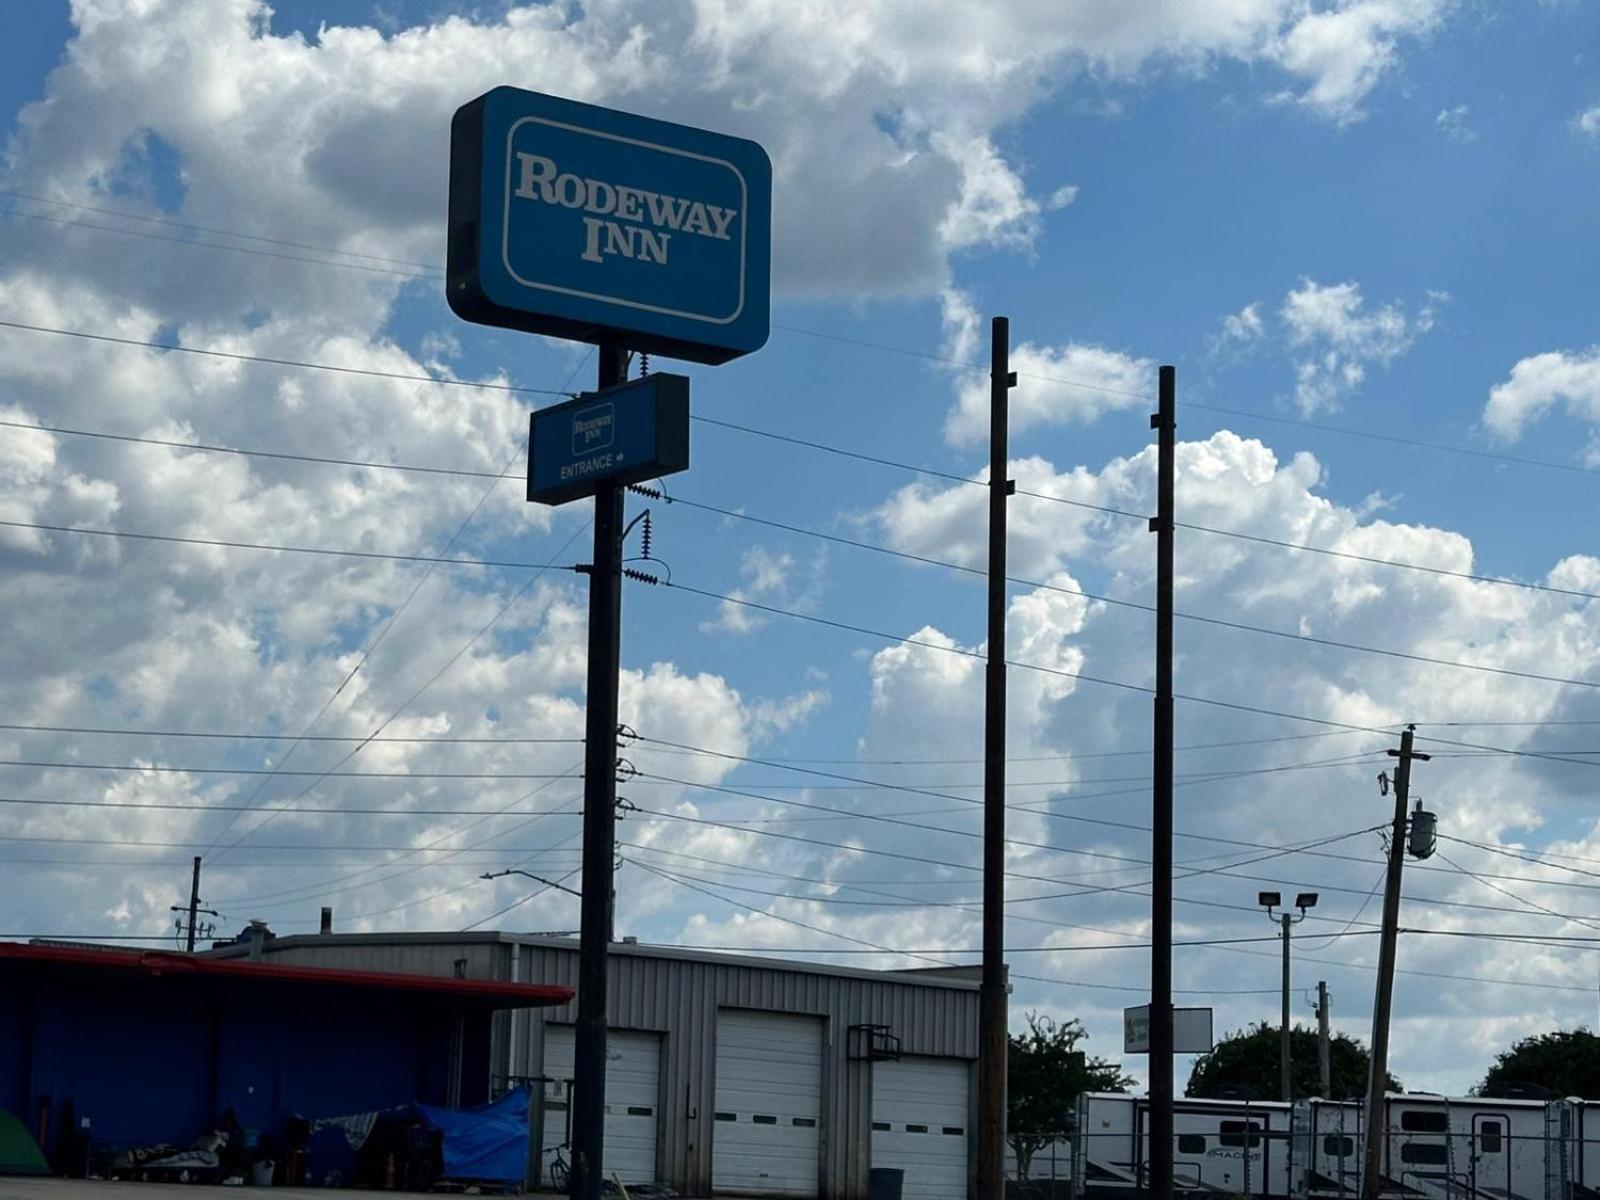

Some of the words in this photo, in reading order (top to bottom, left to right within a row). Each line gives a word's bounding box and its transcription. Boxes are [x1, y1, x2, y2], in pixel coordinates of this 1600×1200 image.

[515, 152, 737, 240] RODEWAY
[581, 217, 671, 265] INN
[560, 454, 613, 480] ENTRANCE
